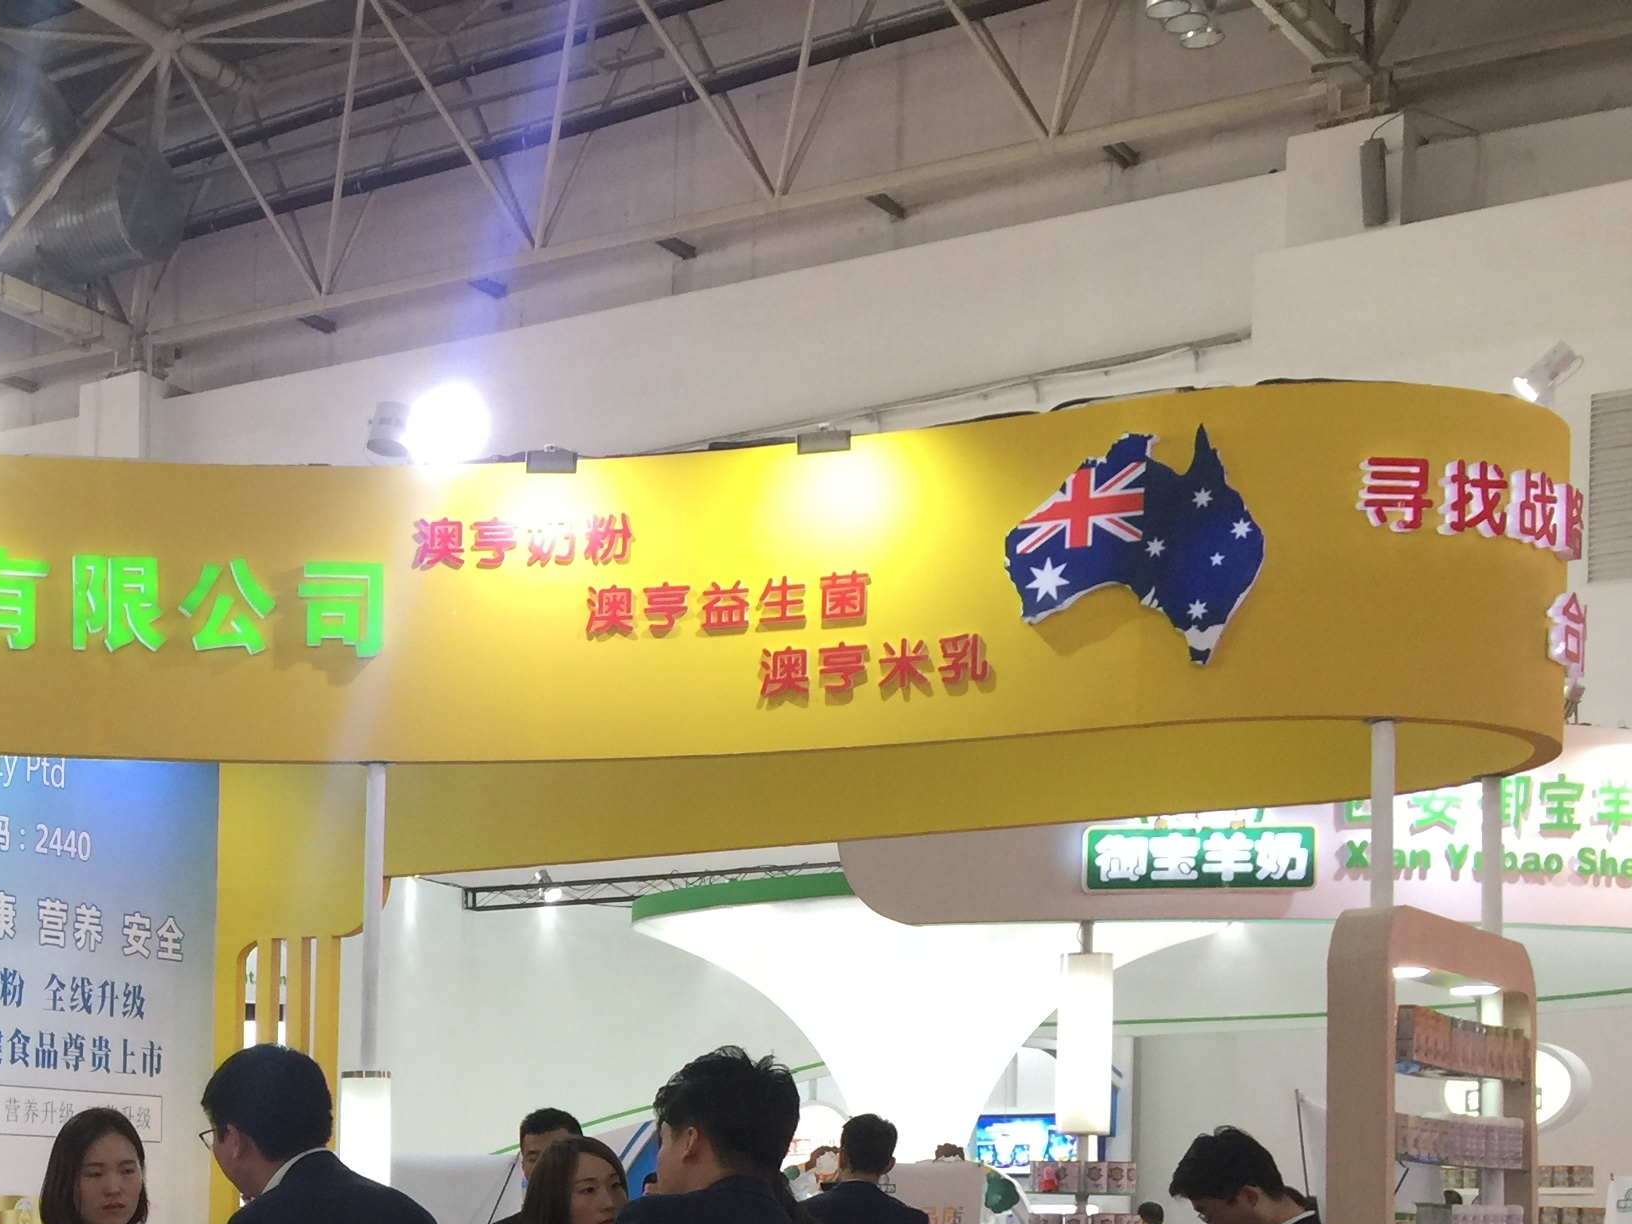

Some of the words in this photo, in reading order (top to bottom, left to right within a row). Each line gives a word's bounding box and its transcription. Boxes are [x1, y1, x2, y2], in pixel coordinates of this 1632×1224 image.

[412, 513, 634, 569] 澳亨奶粉
[585, 569, 870, 636] 澳亨益生菌
[759, 633, 990, 698] 澳亨米乳
[1095, 831, 1308, 881] 御宝羊奶
[38, 899, 104, 951] 营养
[123, 912, 185, 962] 安全
[43, 973, 146, 1020] 全线升级
[5, 1099, 74, 1125] 营养升级
